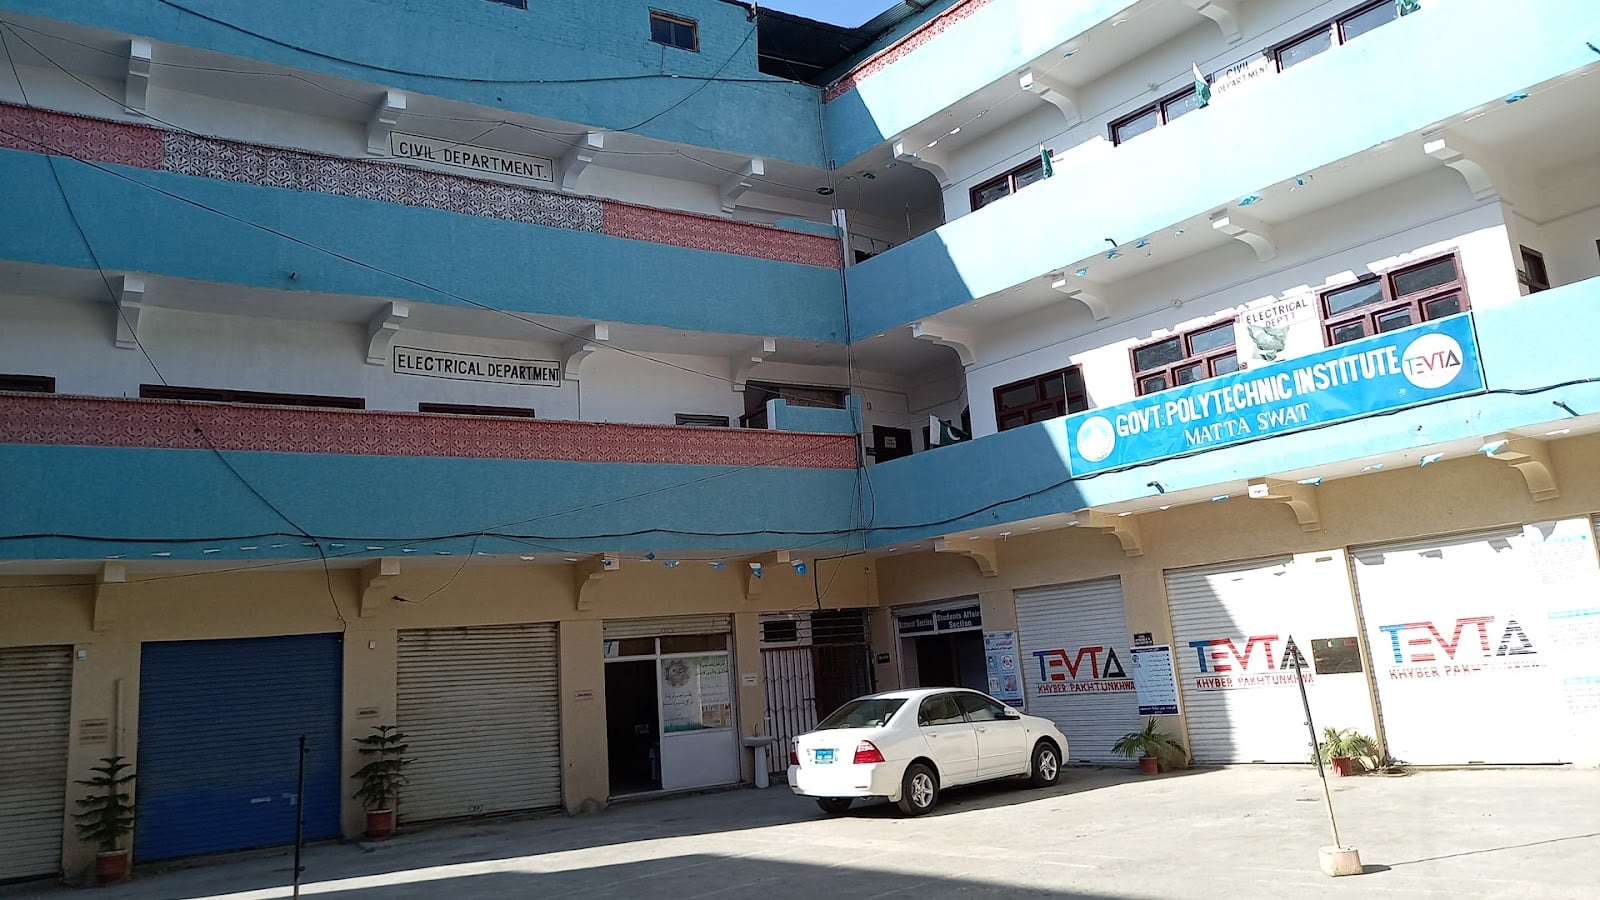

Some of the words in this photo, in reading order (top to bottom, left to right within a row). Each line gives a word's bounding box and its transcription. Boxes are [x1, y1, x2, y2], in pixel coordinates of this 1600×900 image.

[399, 142, 436, 160] CIVIL
[444, 149, 548, 179] DEPARTMENT.
[1246, 299, 1309, 325] ELECTRICAL
[398, 354, 485, 376] ELECTRICAL
[487, 362, 560, 382] DEPARTMENT
[1404, 349, 1461, 376] TEVTA
[1164, 372, 1293, 426] POLYTECHNIC
[1292, 345, 1402, 396] INSTITUTE
[1184, 417, 1251, 447] MATTA
[1257, 402, 1311, 431] SWAT
[948, 619, 973, 629] Section
[1379, 615, 1538, 663] TEVTA
[1033, 645, 1127, 682] TEVTA
[1188, 634, 1310, 673] TEVTA
[1037, 683, 1066, 694] KHYBER
[1195, 677, 1233, 689] KHYBER
